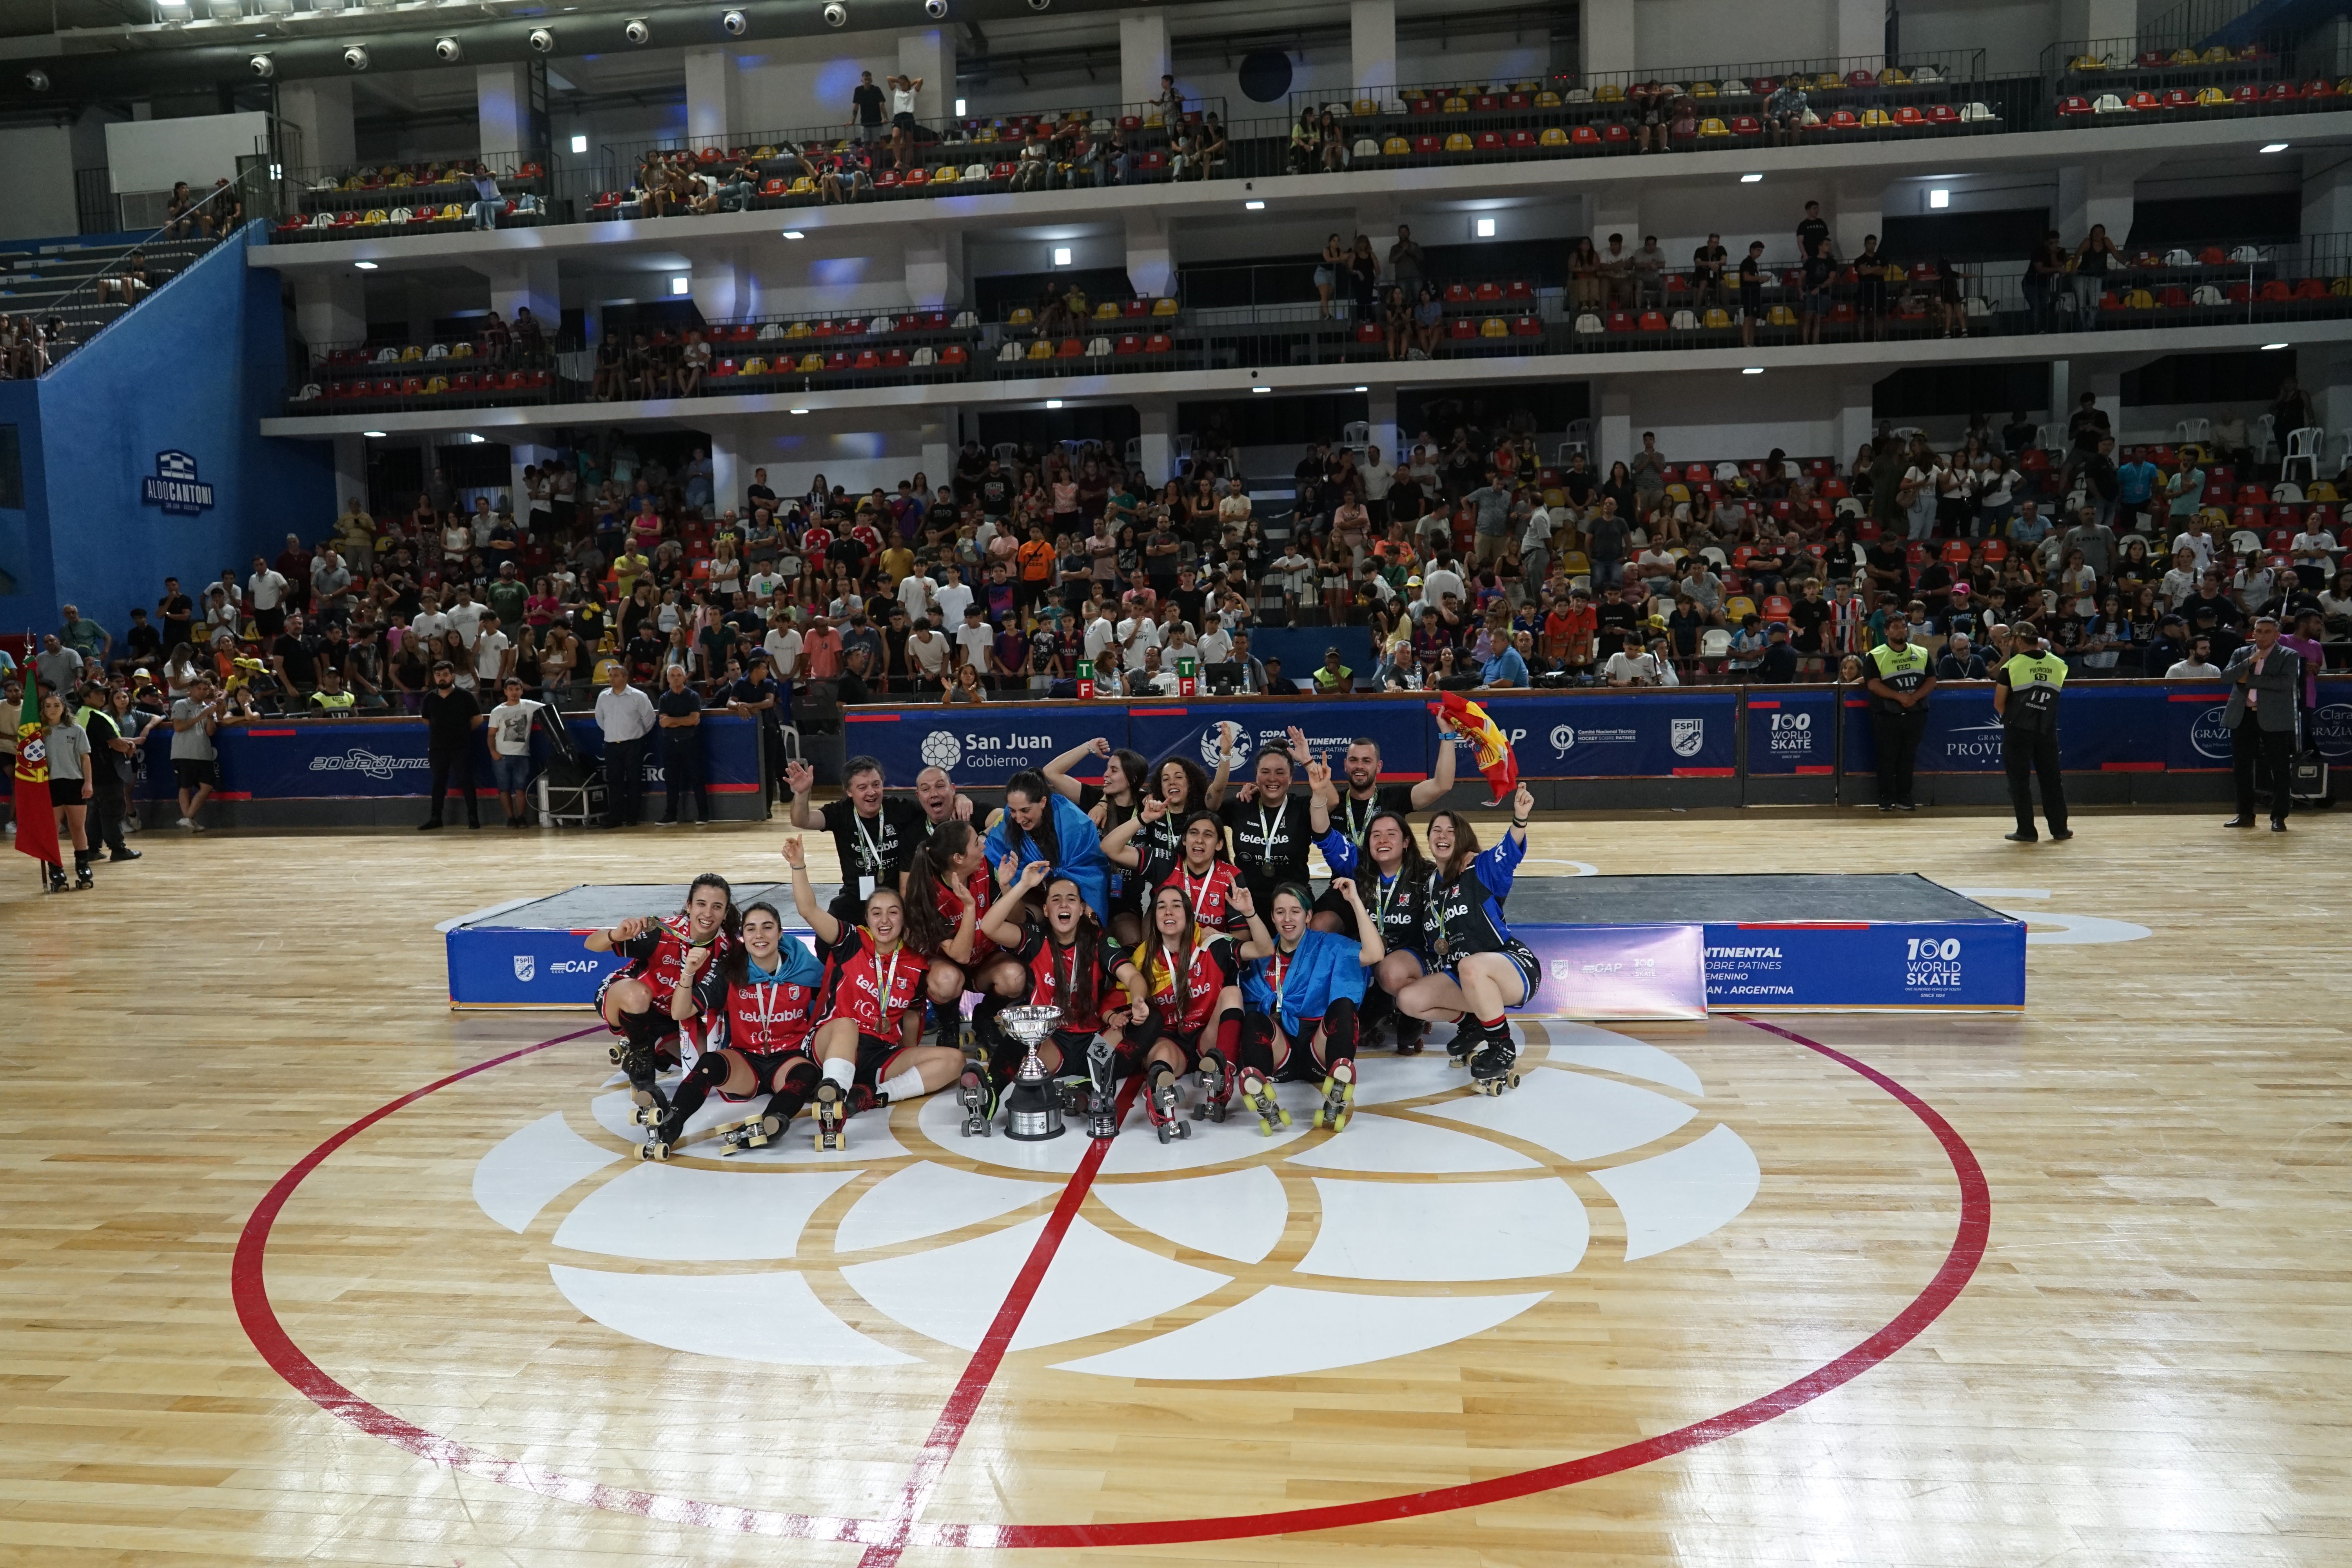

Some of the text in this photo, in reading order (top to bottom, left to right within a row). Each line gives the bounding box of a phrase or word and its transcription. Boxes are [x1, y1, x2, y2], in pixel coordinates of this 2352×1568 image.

[1079, 664, 1089, 677] T
[1181, 661, 1192, 674] T
[1183, 681, 1192, 694] F
[1896, 676, 1917, 687] VIP
[1080, 683, 1090, 696] F
[1771, 713, 1811, 730] 100
[966, 733, 1052, 750] San Juan
[1771, 731, 1811, 739] WORLD
[1771, 740, 1811, 750] SKATE
[967, 754, 1027, 767] Gobierno
[1240, 832, 1289, 845] telecble
[1907, 938, 1960, 960] 100
[565, 960, 598, 973] CAP
[1594, 964, 1622, 973] CAP
[1907, 962, 1961, 972] WORLD
[1906, 973, 1961, 985] SKATE
